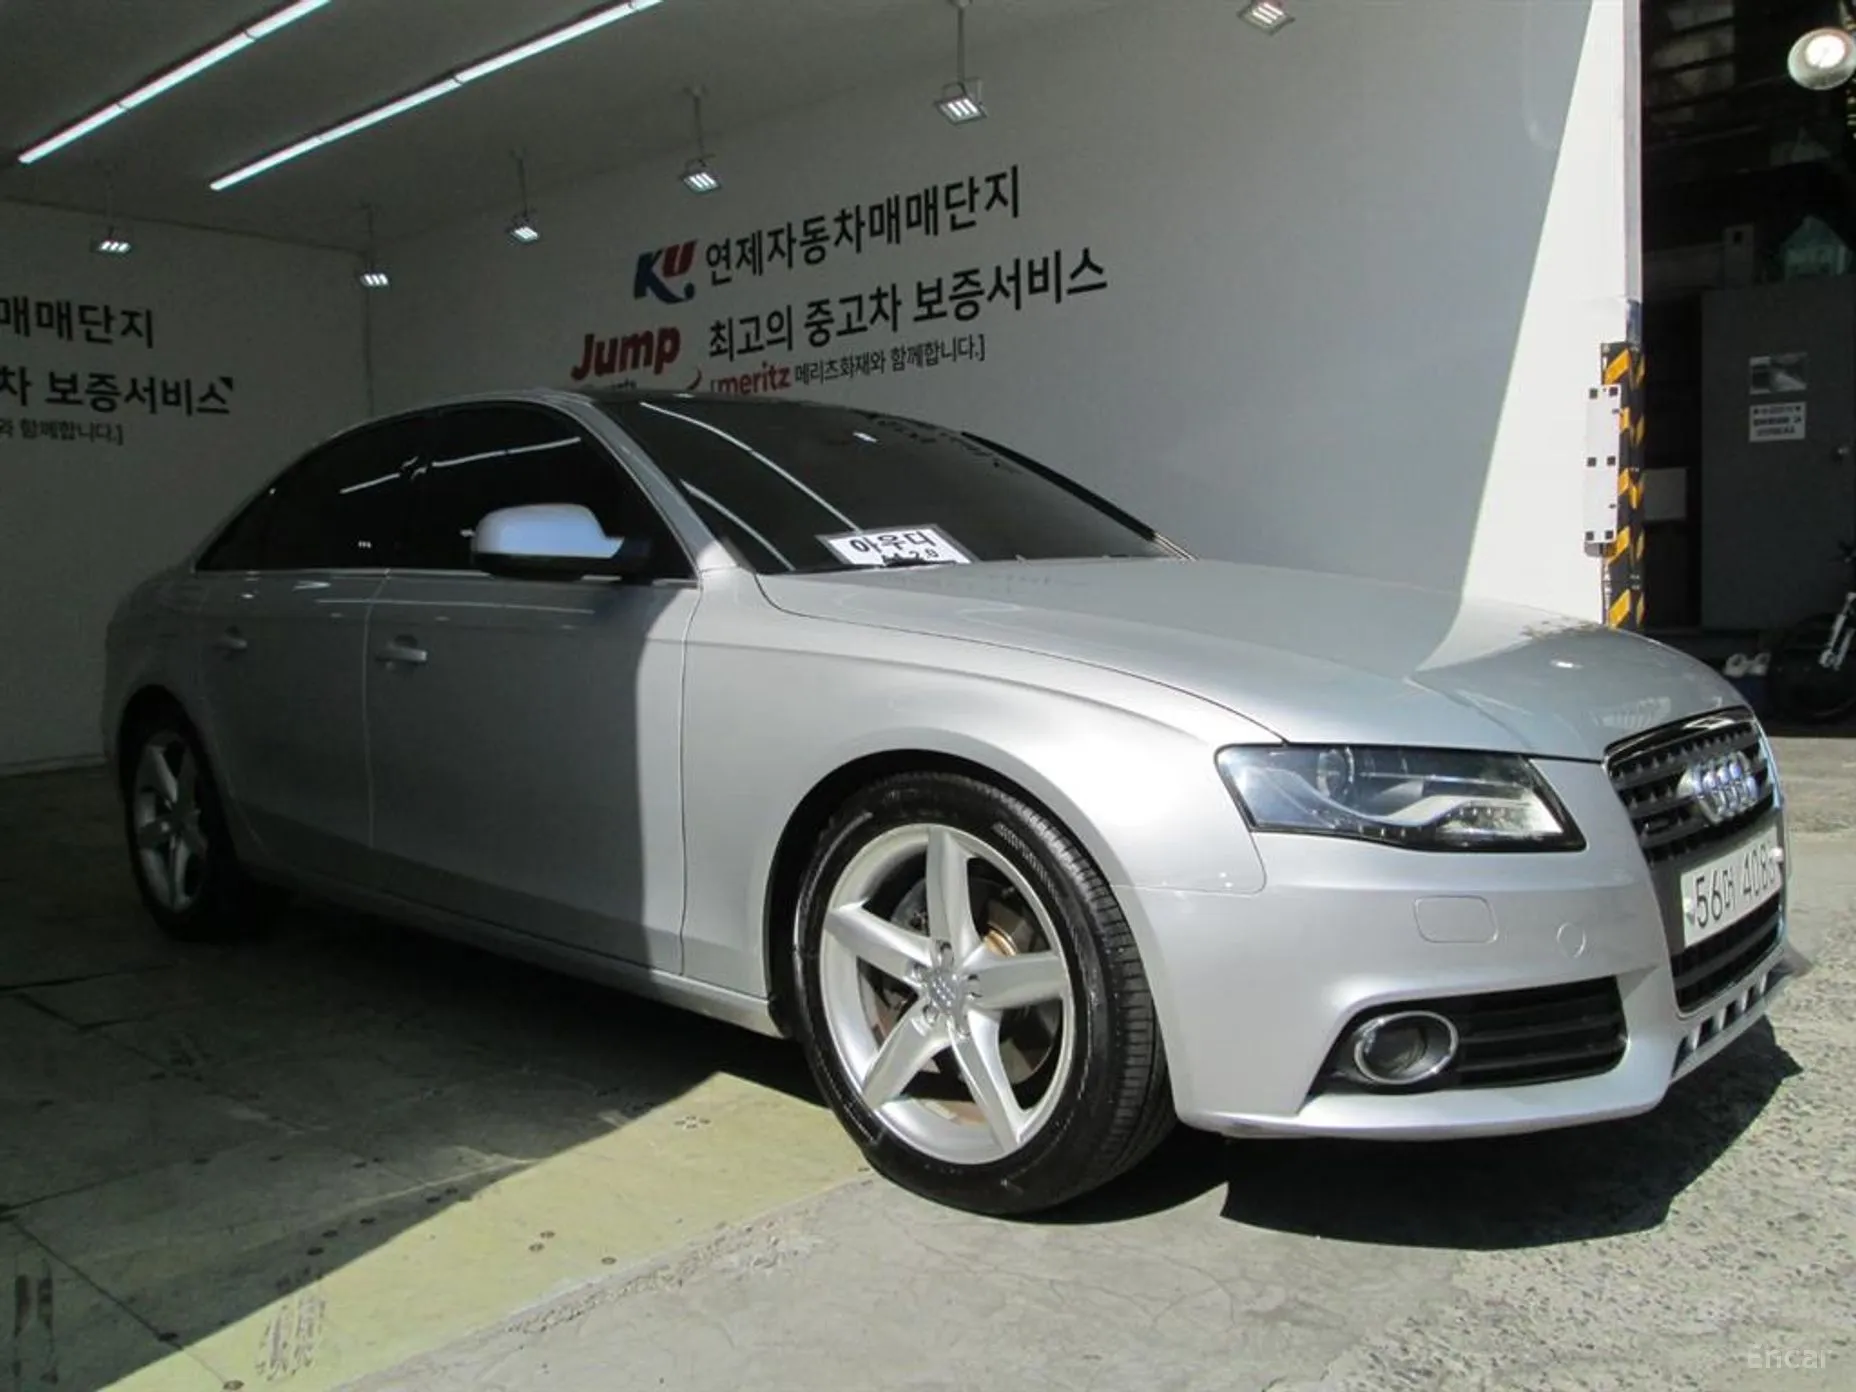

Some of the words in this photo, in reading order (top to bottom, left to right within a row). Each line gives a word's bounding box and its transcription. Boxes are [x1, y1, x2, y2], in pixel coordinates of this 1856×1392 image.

[705, 164, 1019, 286] 연제자동차매매단지
[0, 296, 153, 349] 매매단지
[709, 304, 793, 362] 최고의
[804, 283, 902, 348] 중고차
[913, 247, 1108, 322] 보증서비스
[570, 326, 681, 381] Jump
[45, 370, 230, 417] 보증서비스
[849, 530, 937, 553] 아우디
